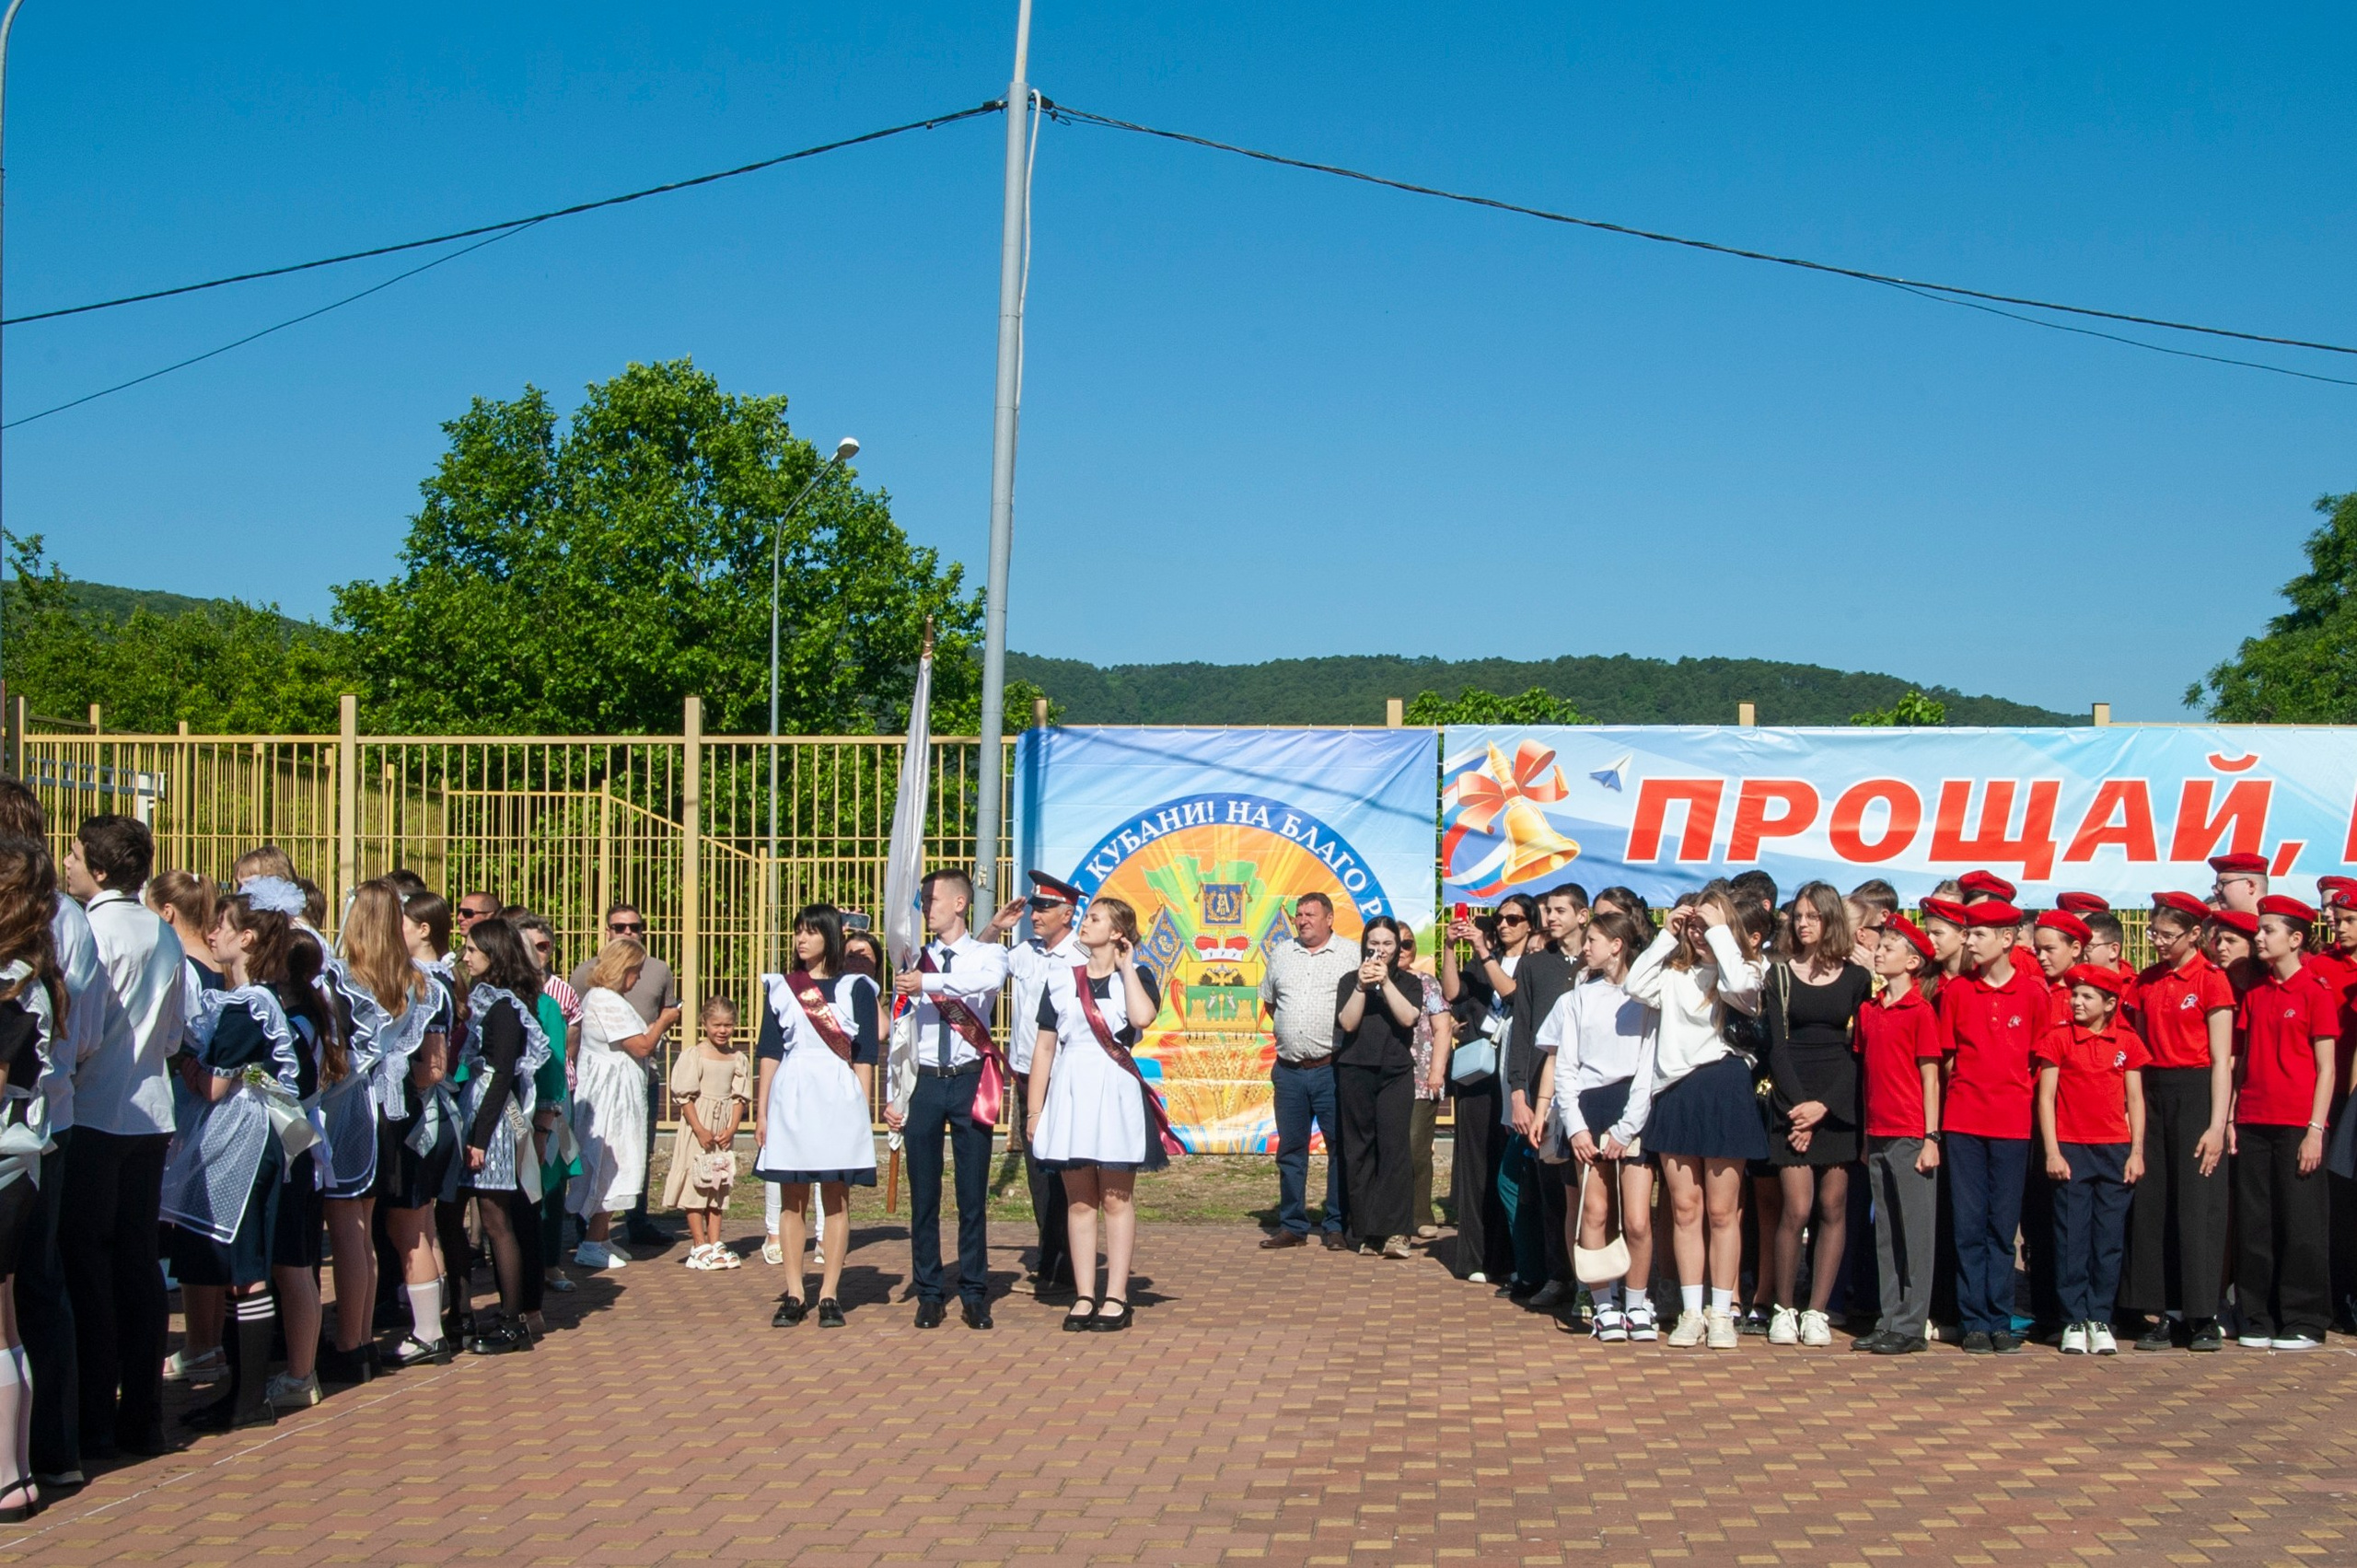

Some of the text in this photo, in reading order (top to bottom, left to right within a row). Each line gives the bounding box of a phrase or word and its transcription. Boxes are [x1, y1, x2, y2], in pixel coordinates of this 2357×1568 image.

[1085, 800, 1215, 883] КУБАНИ!
[1225, 800, 1271, 829] НА
[1279, 813, 1367, 892] БЛАГО
[1358, 896, 1383, 915] Р
[1625, 753, 2305, 880] ПРОЩАЙ,
[505, 1100, 528, 1141] 2024
